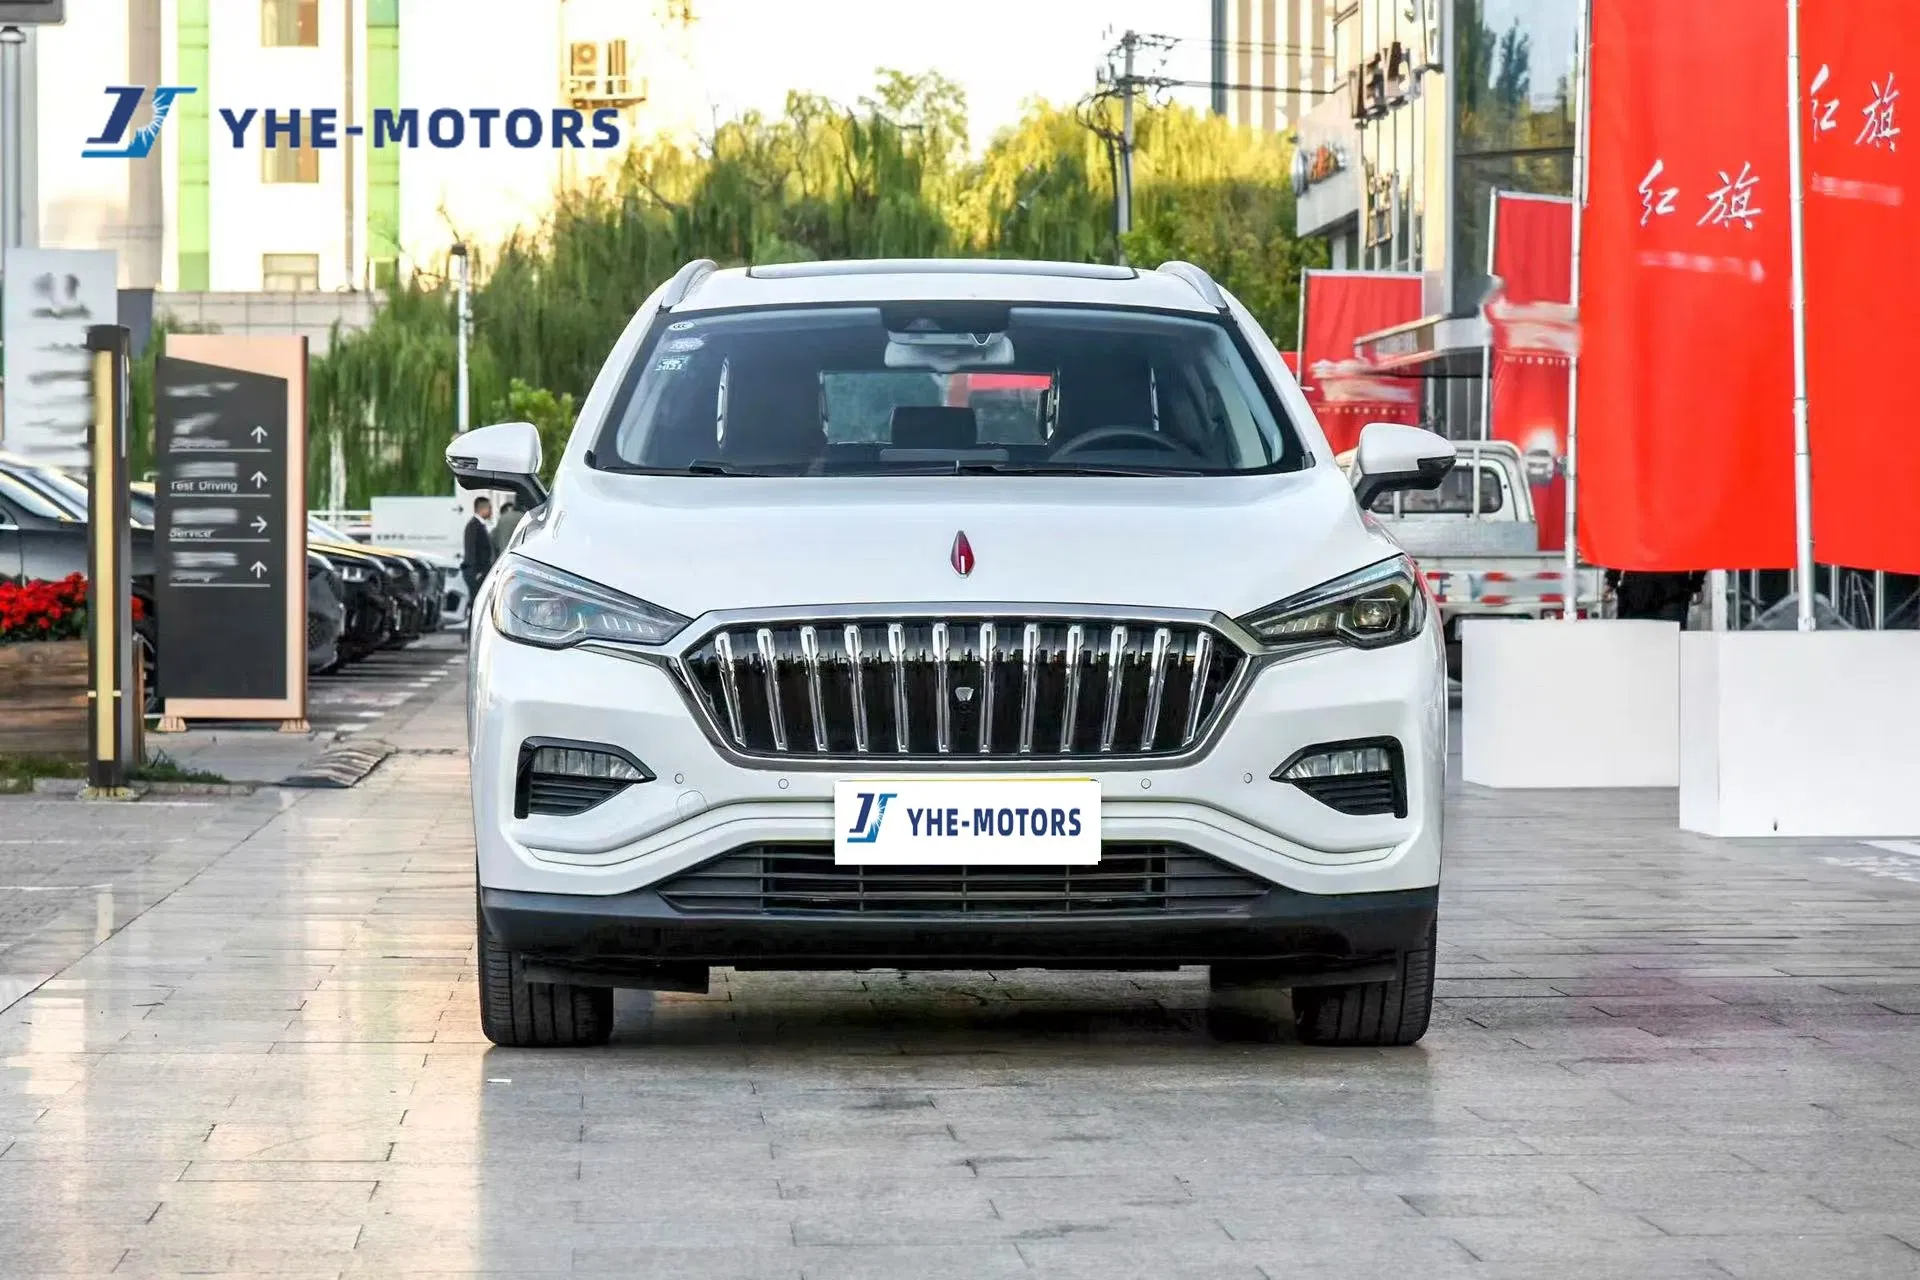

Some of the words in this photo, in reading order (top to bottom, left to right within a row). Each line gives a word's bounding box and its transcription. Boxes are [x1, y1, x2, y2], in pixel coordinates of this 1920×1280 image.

[1811, 63, 1901, 152] 红旗
[1638, 159, 1763, 231] 红旗
[171, 480, 194, 491] Test
[198, 480, 238, 493] Driving
